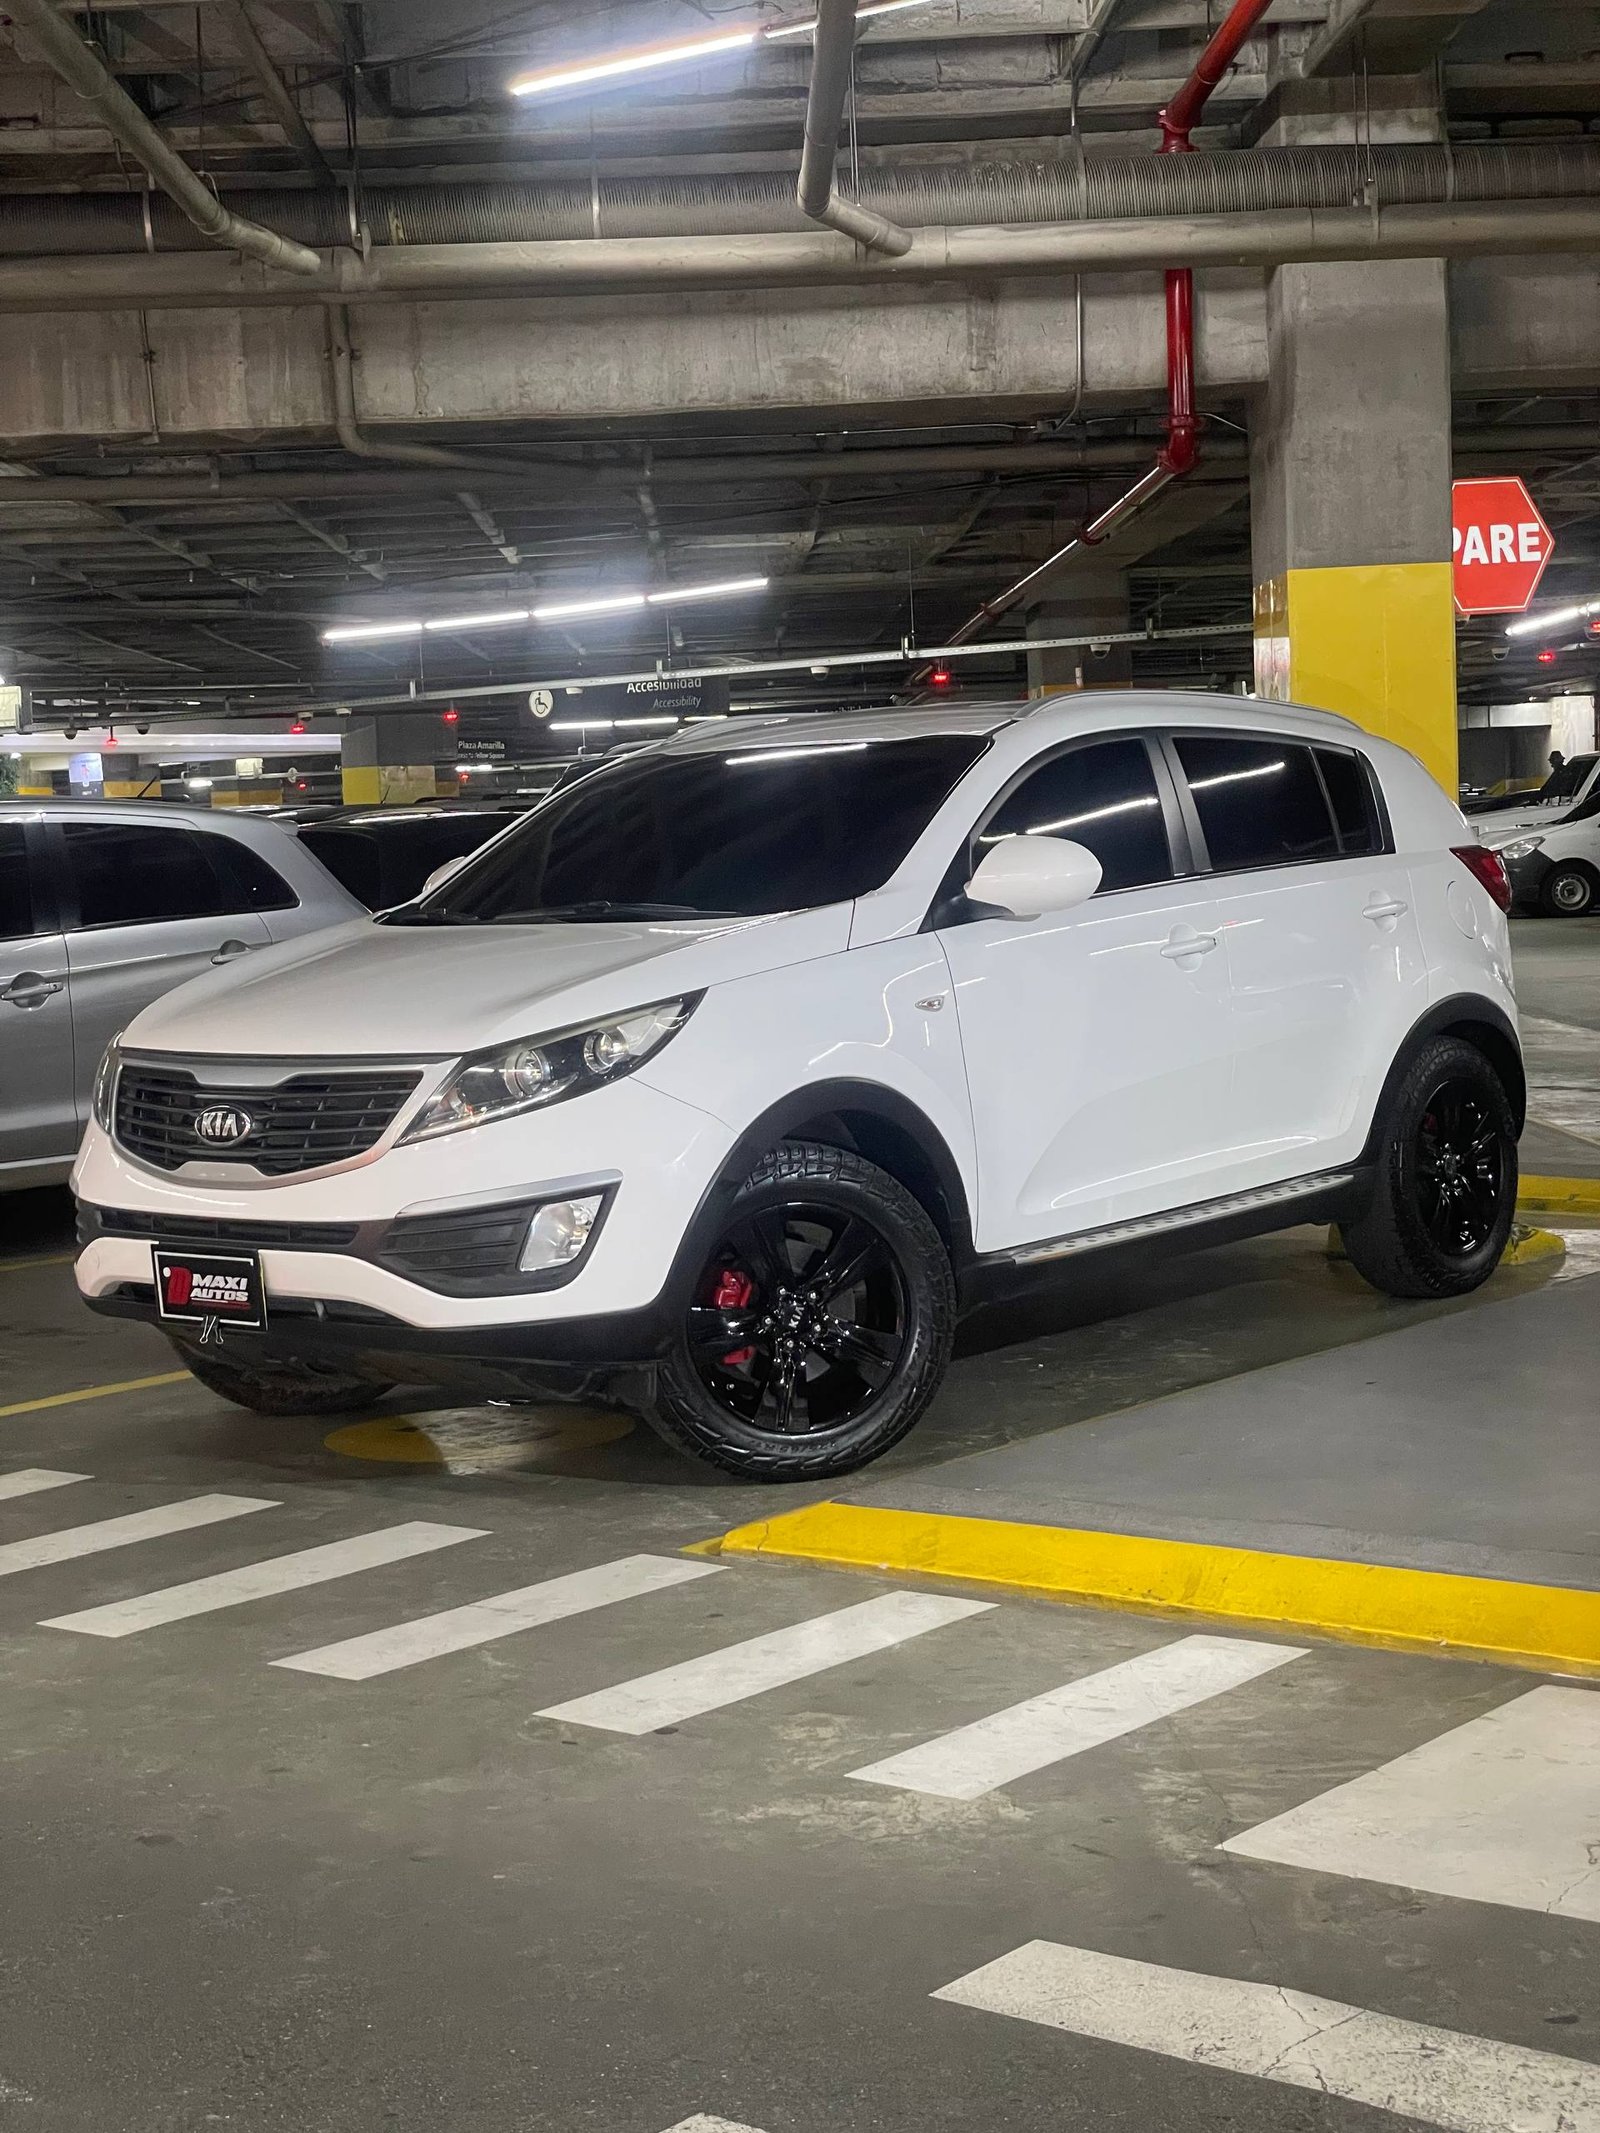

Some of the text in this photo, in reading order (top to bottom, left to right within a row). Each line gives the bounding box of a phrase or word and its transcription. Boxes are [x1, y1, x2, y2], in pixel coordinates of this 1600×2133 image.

[652, 694, 702, 709] Accessibility
[458, 740, 505, 750] Plaza Amarilla
[201, 1111, 239, 1137] KIA
[192, 1273, 248, 1291] MAXI
[190, 1287, 249, 1302] AUTOS
[789, 1306, 805, 1329] KIA
